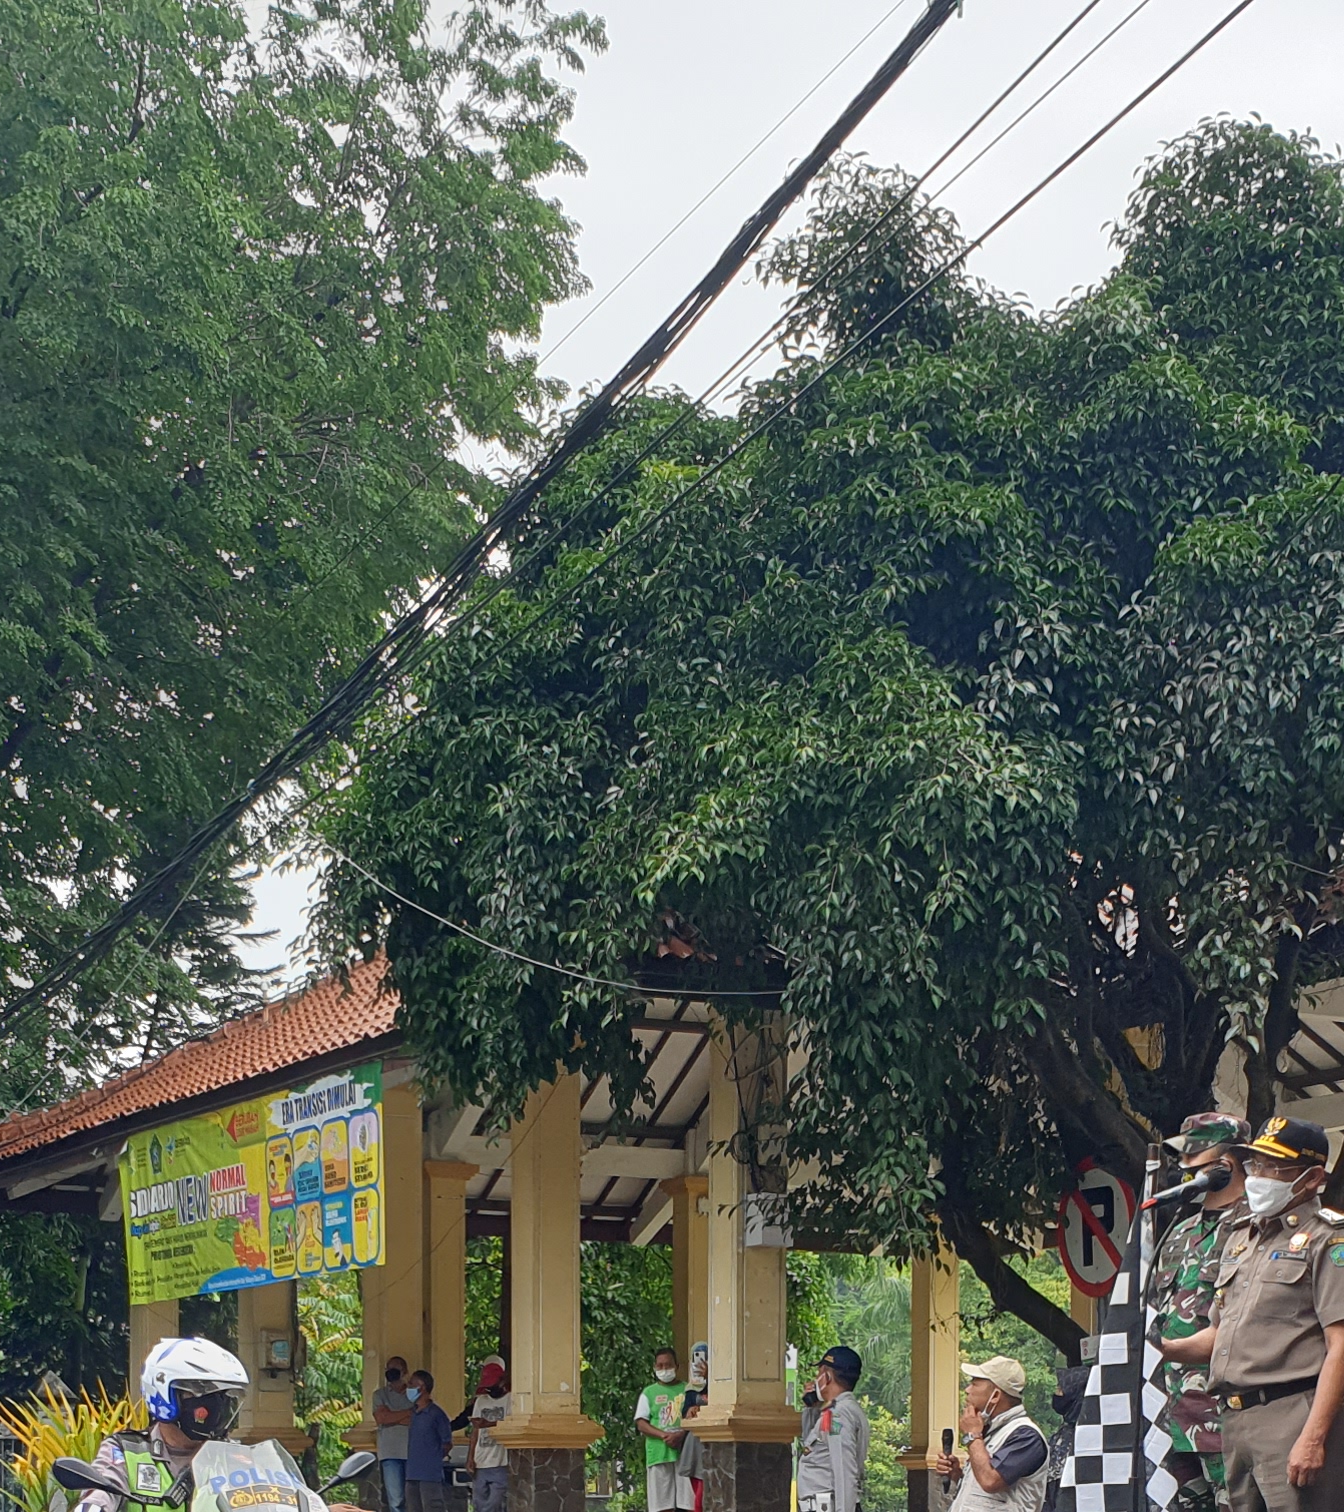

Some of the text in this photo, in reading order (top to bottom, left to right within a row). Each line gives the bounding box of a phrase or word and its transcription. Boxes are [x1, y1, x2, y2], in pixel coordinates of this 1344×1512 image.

[281, 1100, 295, 1125] ERA
[327, 1080, 357, 1112] DIMULAI
[210, 1164, 246, 1193] NORMAL
[176, 1172, 209, 1226] NEW
[211, 1191, 248, 1220] SPIRIT
